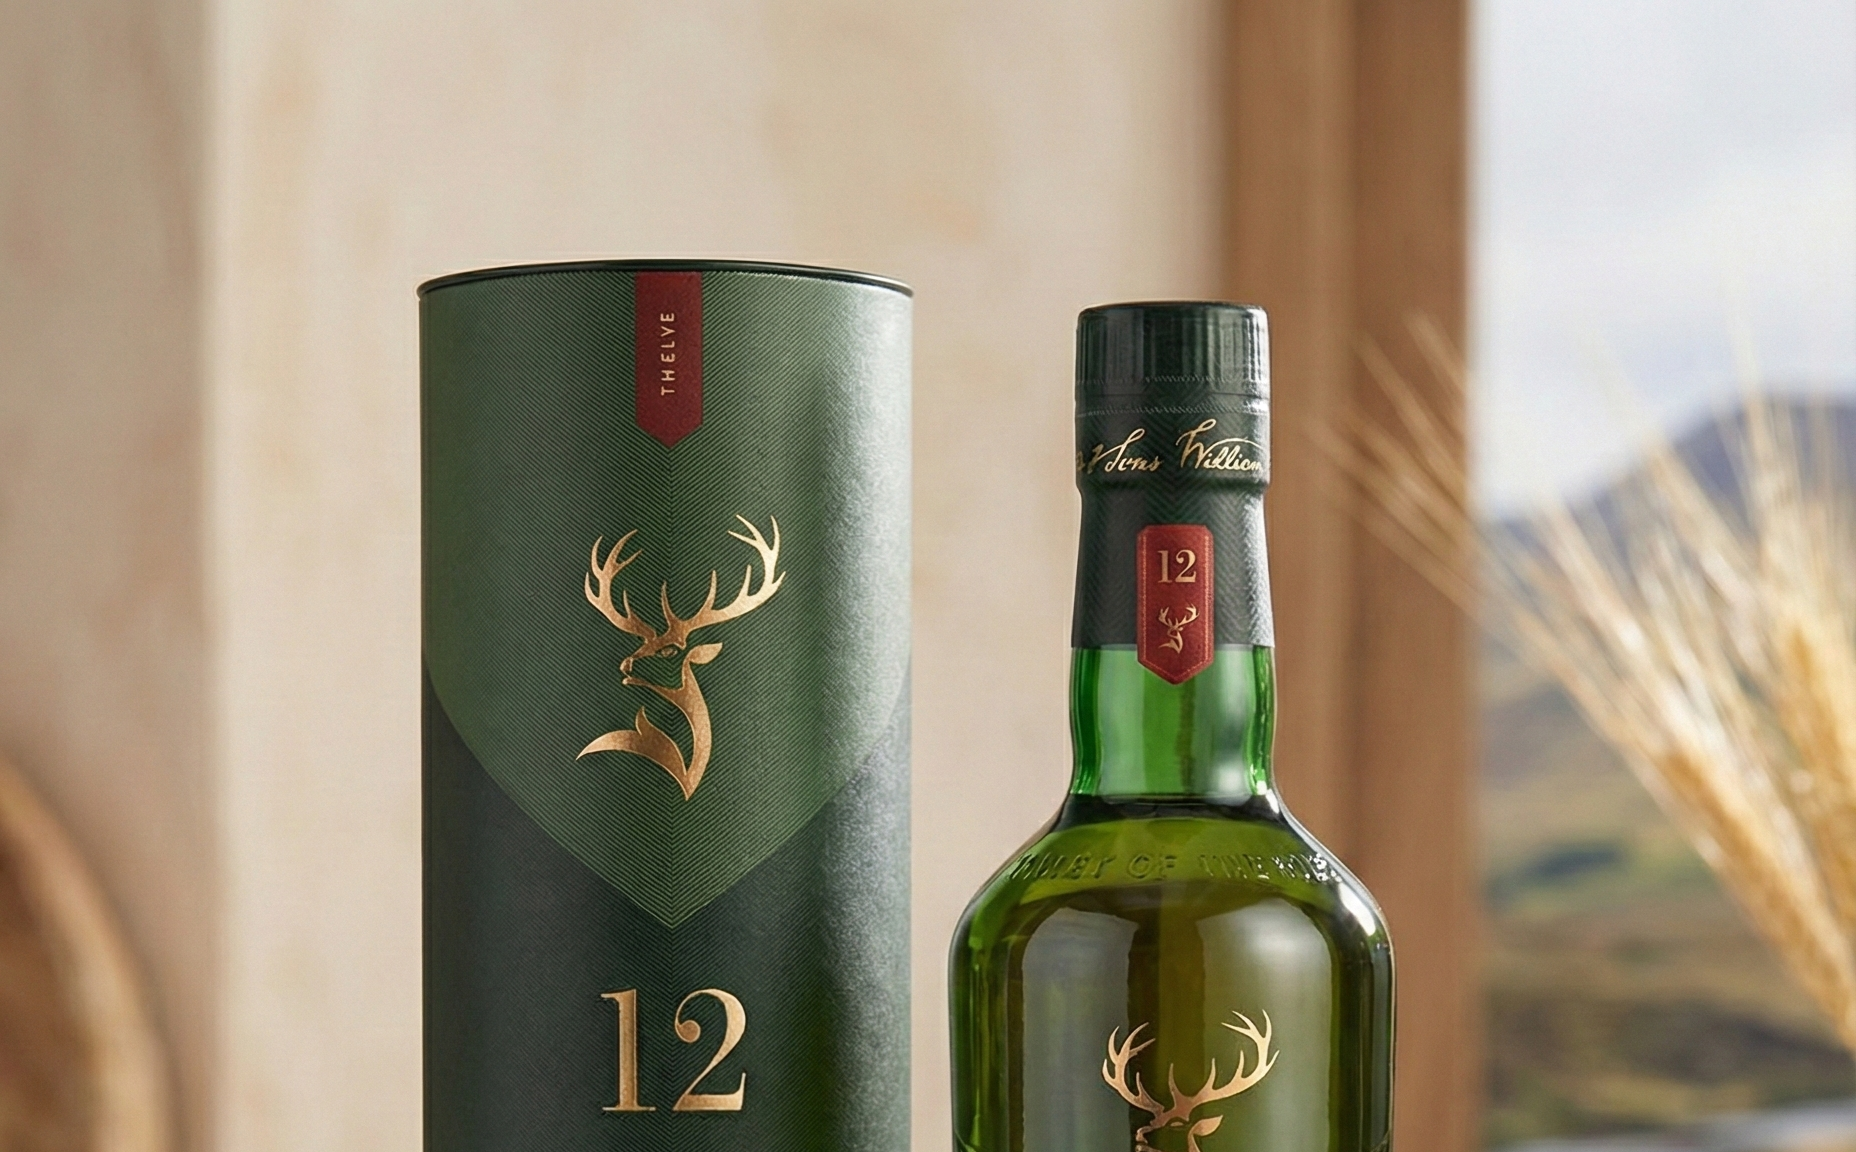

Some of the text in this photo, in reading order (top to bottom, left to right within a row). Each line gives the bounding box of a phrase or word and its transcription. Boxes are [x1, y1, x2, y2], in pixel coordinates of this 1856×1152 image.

[660, 312, 676, 396] THELVE
[1157, 549, 1197, 583] 12
[601, 988, 746, 1111] 12
